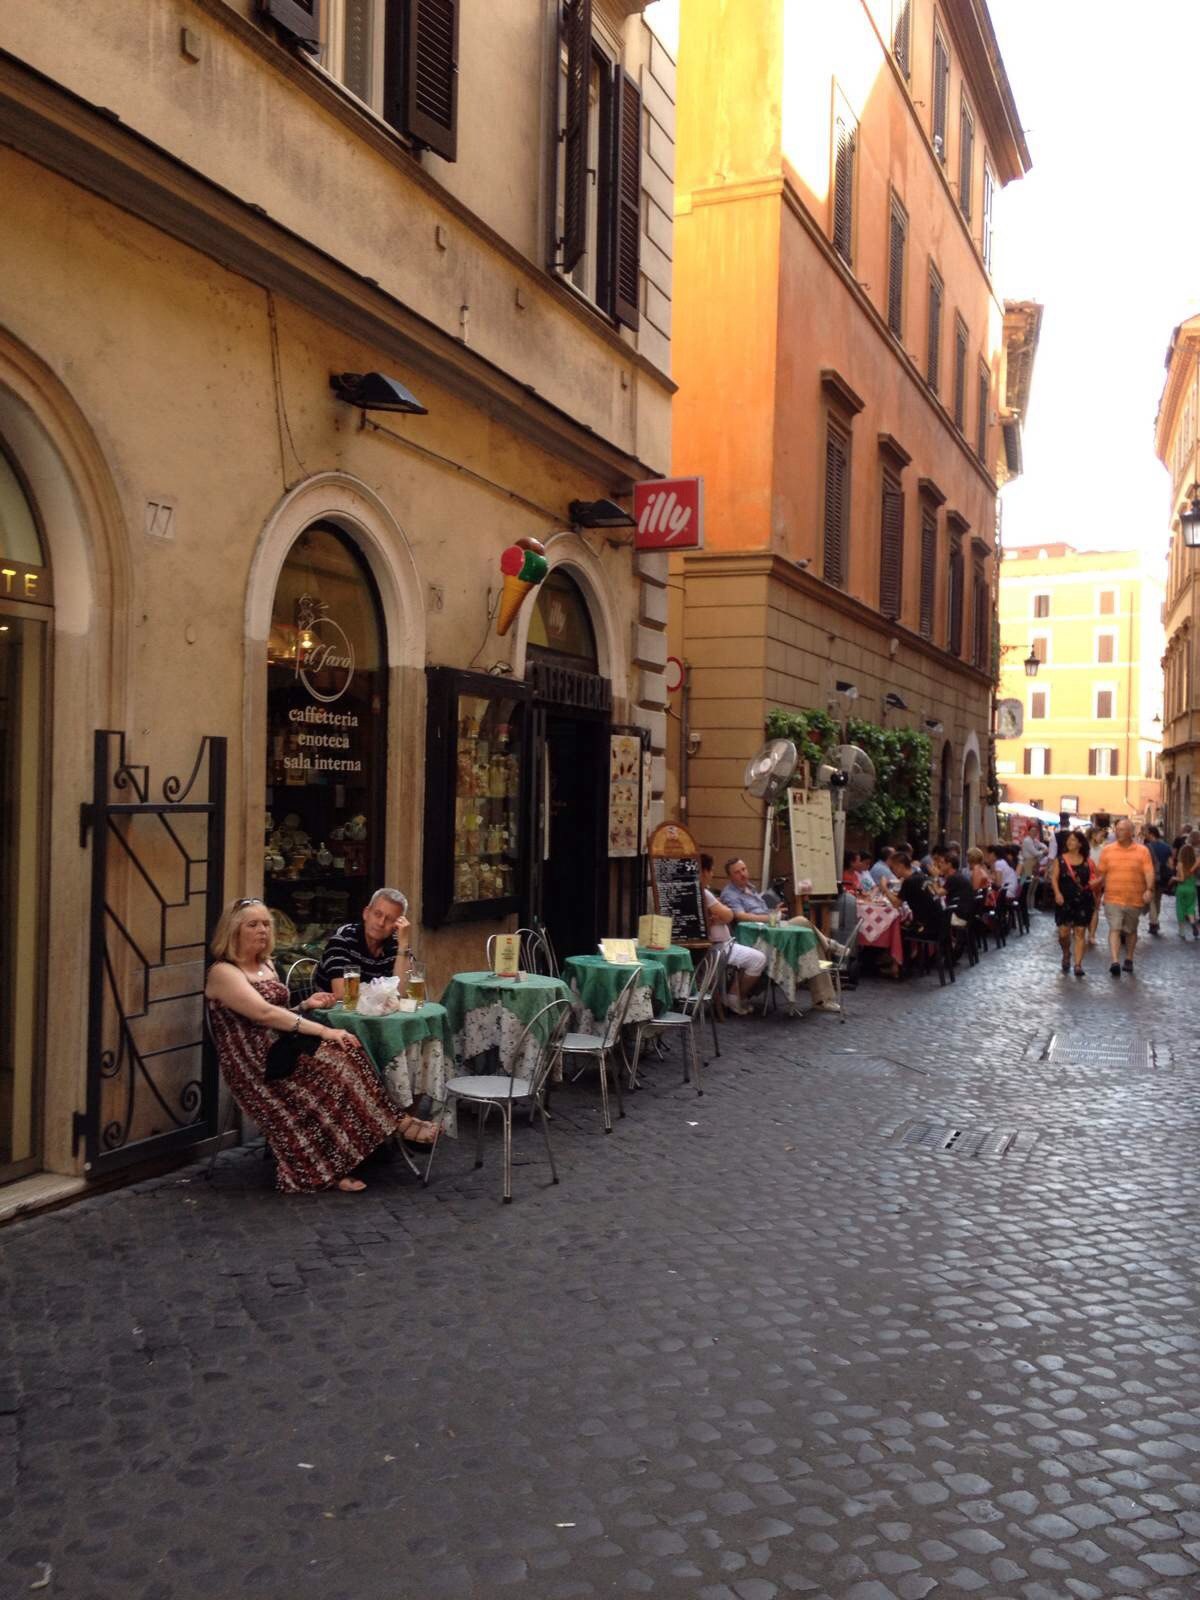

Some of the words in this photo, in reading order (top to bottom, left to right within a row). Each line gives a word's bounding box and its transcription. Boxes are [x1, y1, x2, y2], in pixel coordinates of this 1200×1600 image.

[148, 501, 173, 536] 77
[638, 491, 692, 542] illy
[1, 569, 38, 597] TE
[313, 645, 352, 673] faro
[288, 706, 359, 727] caffetteria
[298, 734, 350, 749] enoteca
[283, 753, 311, 769] sala
[315, 755, 361, 771] interna
